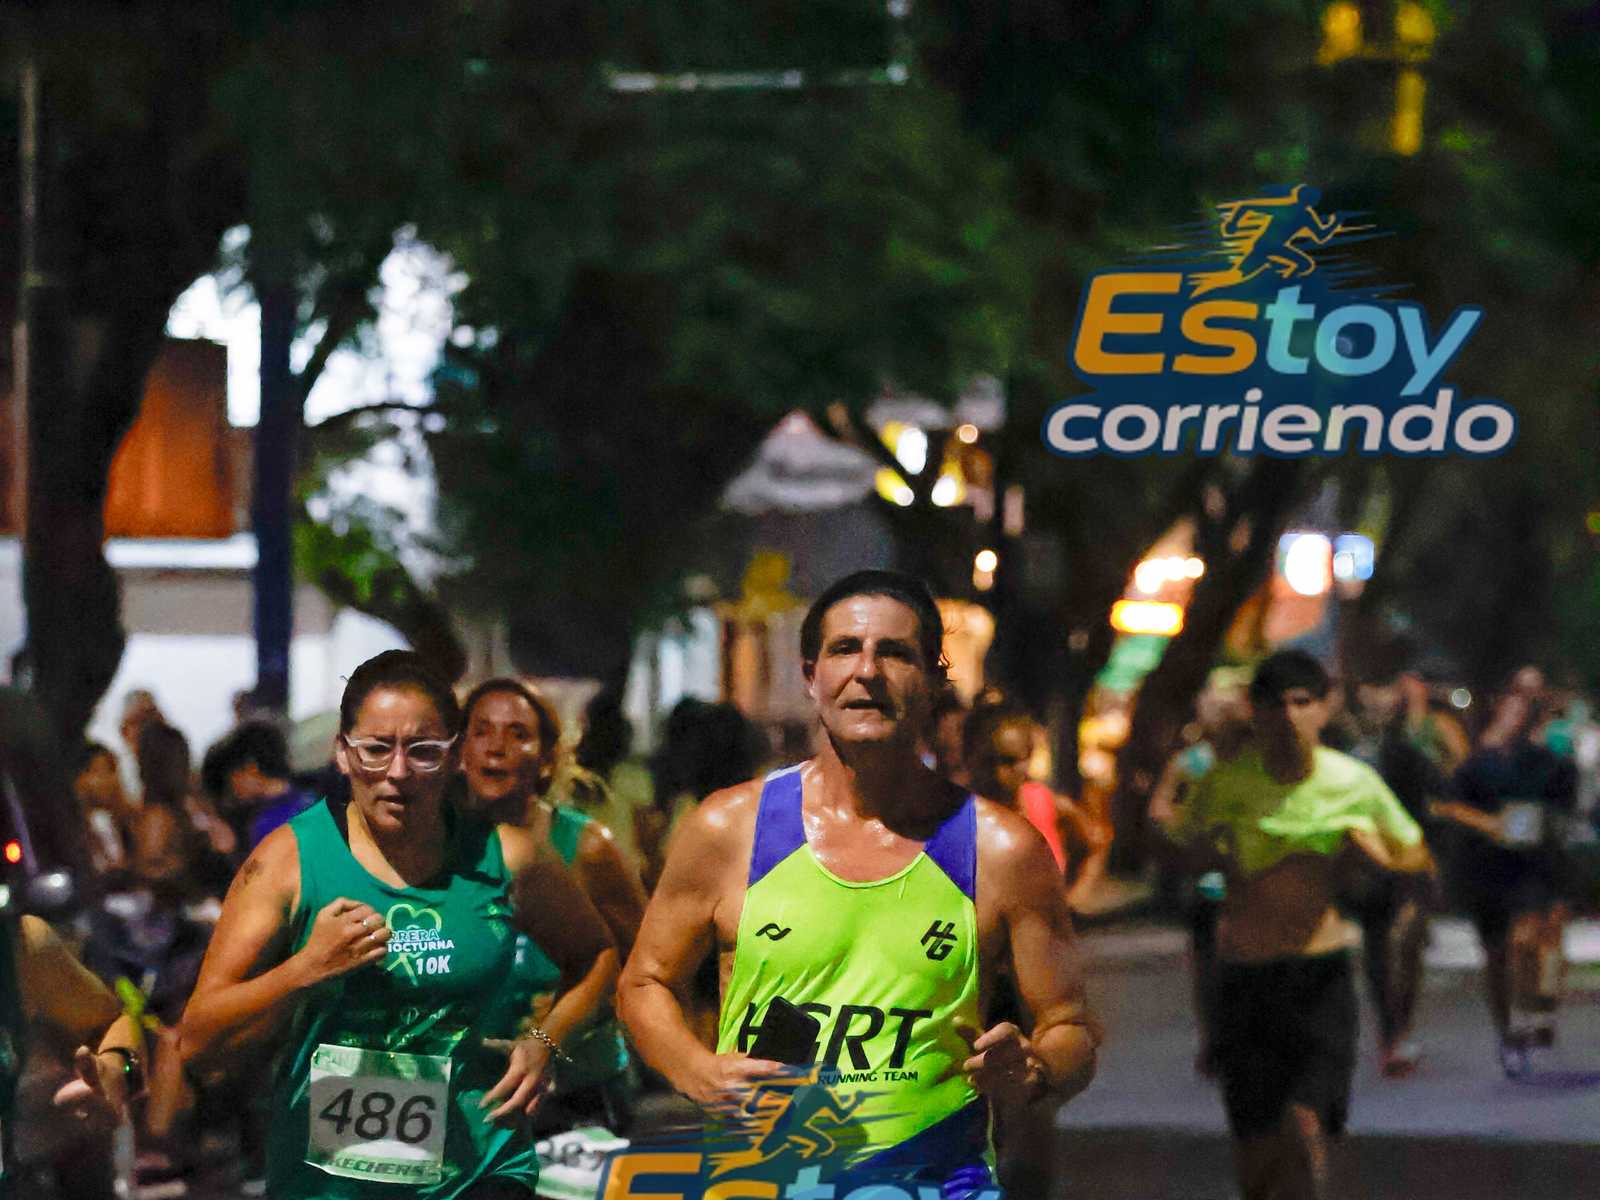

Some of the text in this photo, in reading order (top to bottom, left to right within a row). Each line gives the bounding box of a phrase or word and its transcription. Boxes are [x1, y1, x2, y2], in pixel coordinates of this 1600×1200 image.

[389, 928, 440, 942] RRERA
[415, 955, 451, 975] 10K
[818, 1071, 918, 1085] RUNNING TEAM
[319, 1088, 436, 1143] 486
